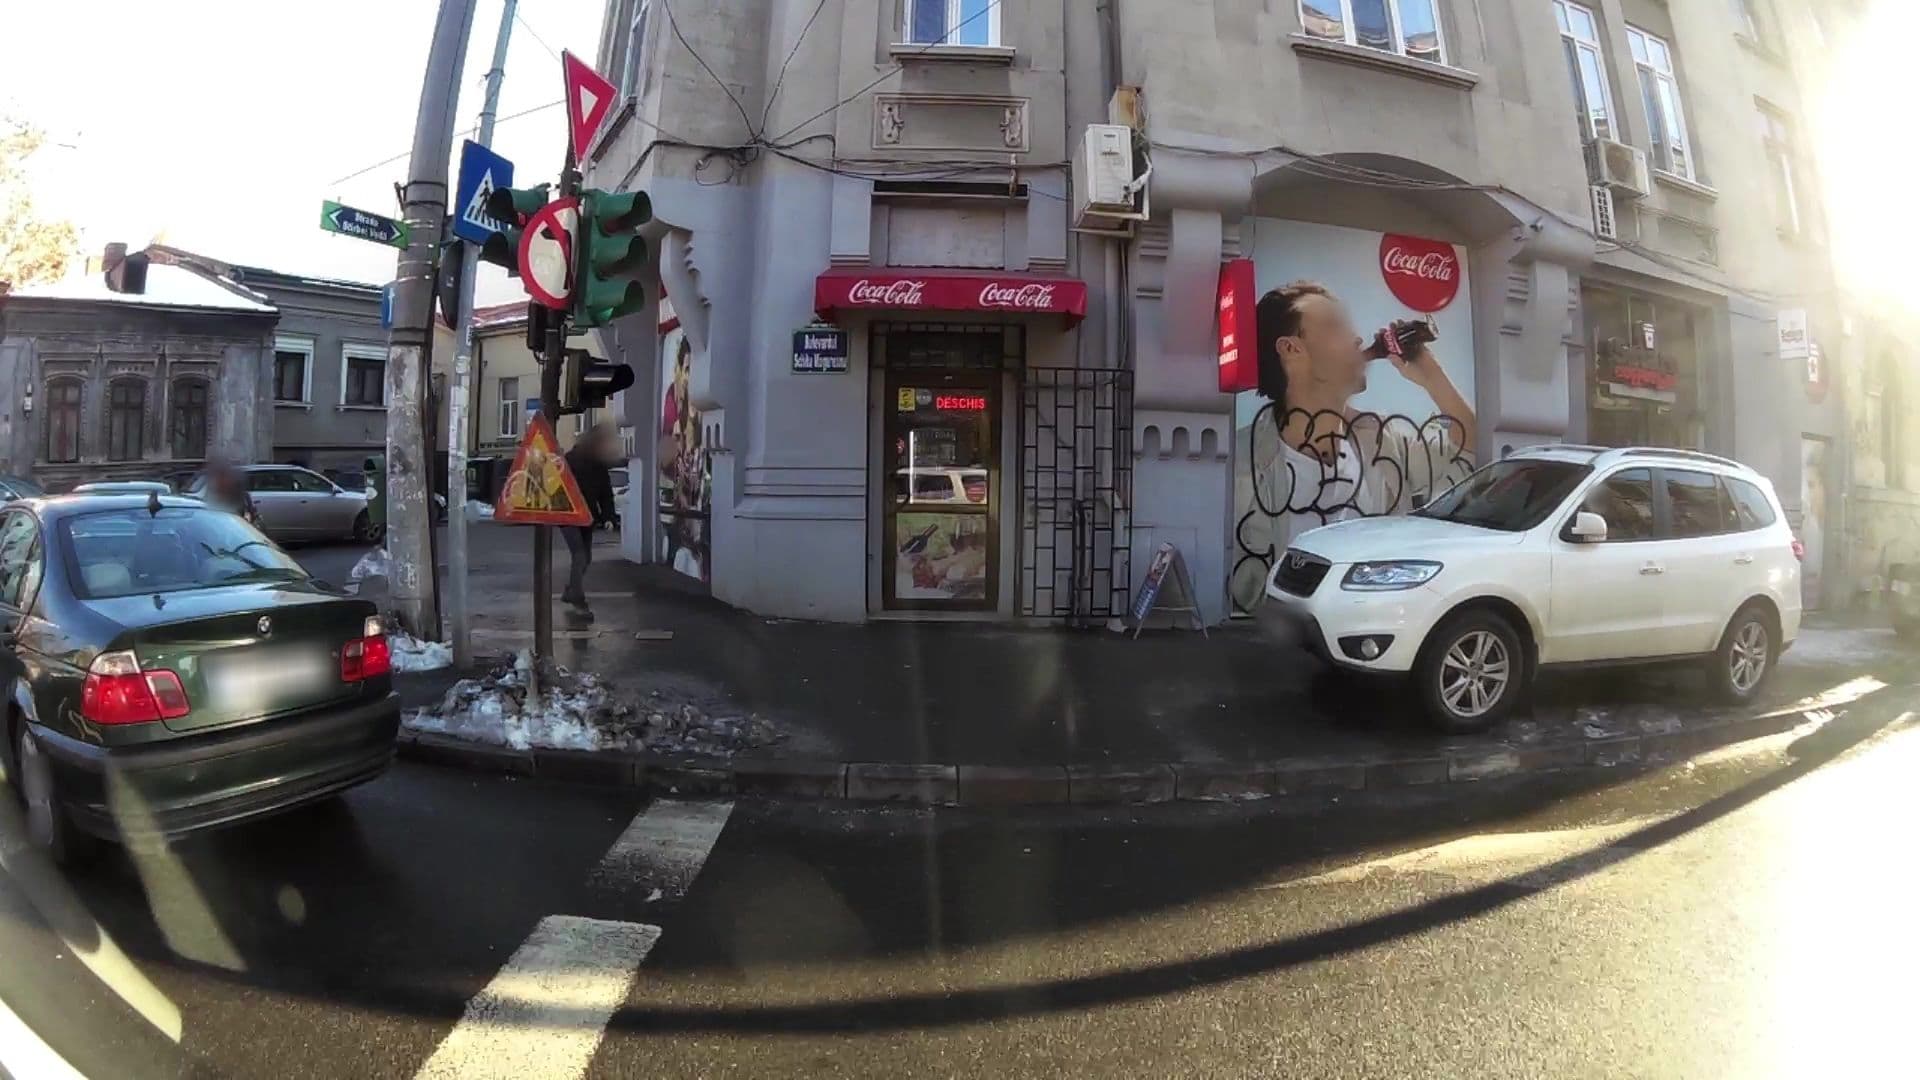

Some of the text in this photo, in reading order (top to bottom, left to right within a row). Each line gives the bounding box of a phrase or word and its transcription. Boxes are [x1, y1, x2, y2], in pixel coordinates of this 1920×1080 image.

[1384, 246, 1455, 281] Coca-Cola
[849, 279, 927, 305] Coca-Cola
[979, 282, 1056, 308] Coca-Cola
[936, 396, 986, 410] DESCHIS
